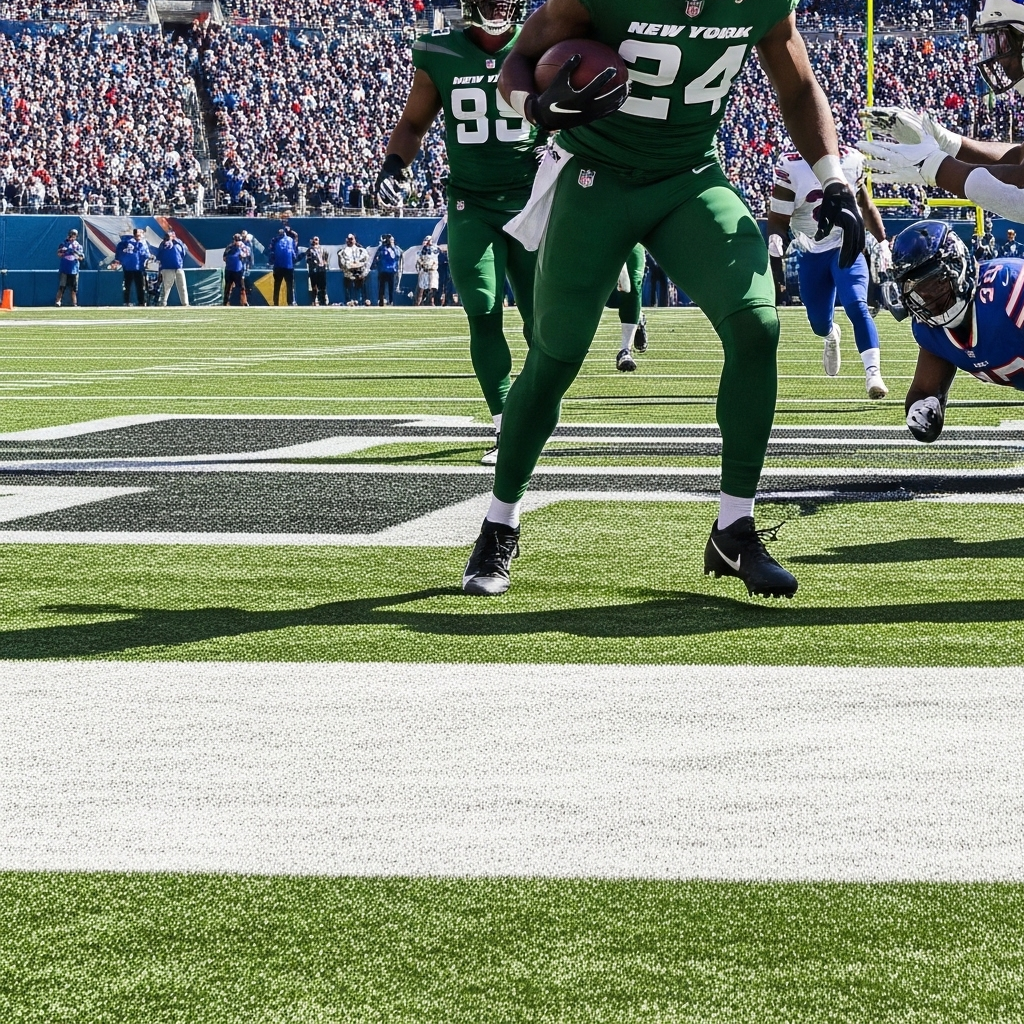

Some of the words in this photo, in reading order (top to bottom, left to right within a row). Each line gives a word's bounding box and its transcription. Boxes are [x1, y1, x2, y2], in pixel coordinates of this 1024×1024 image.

[627, 21, 686, 38] NEW
[688, 25, 753, 39] YORK
[618, 39, 748, 121] 24
